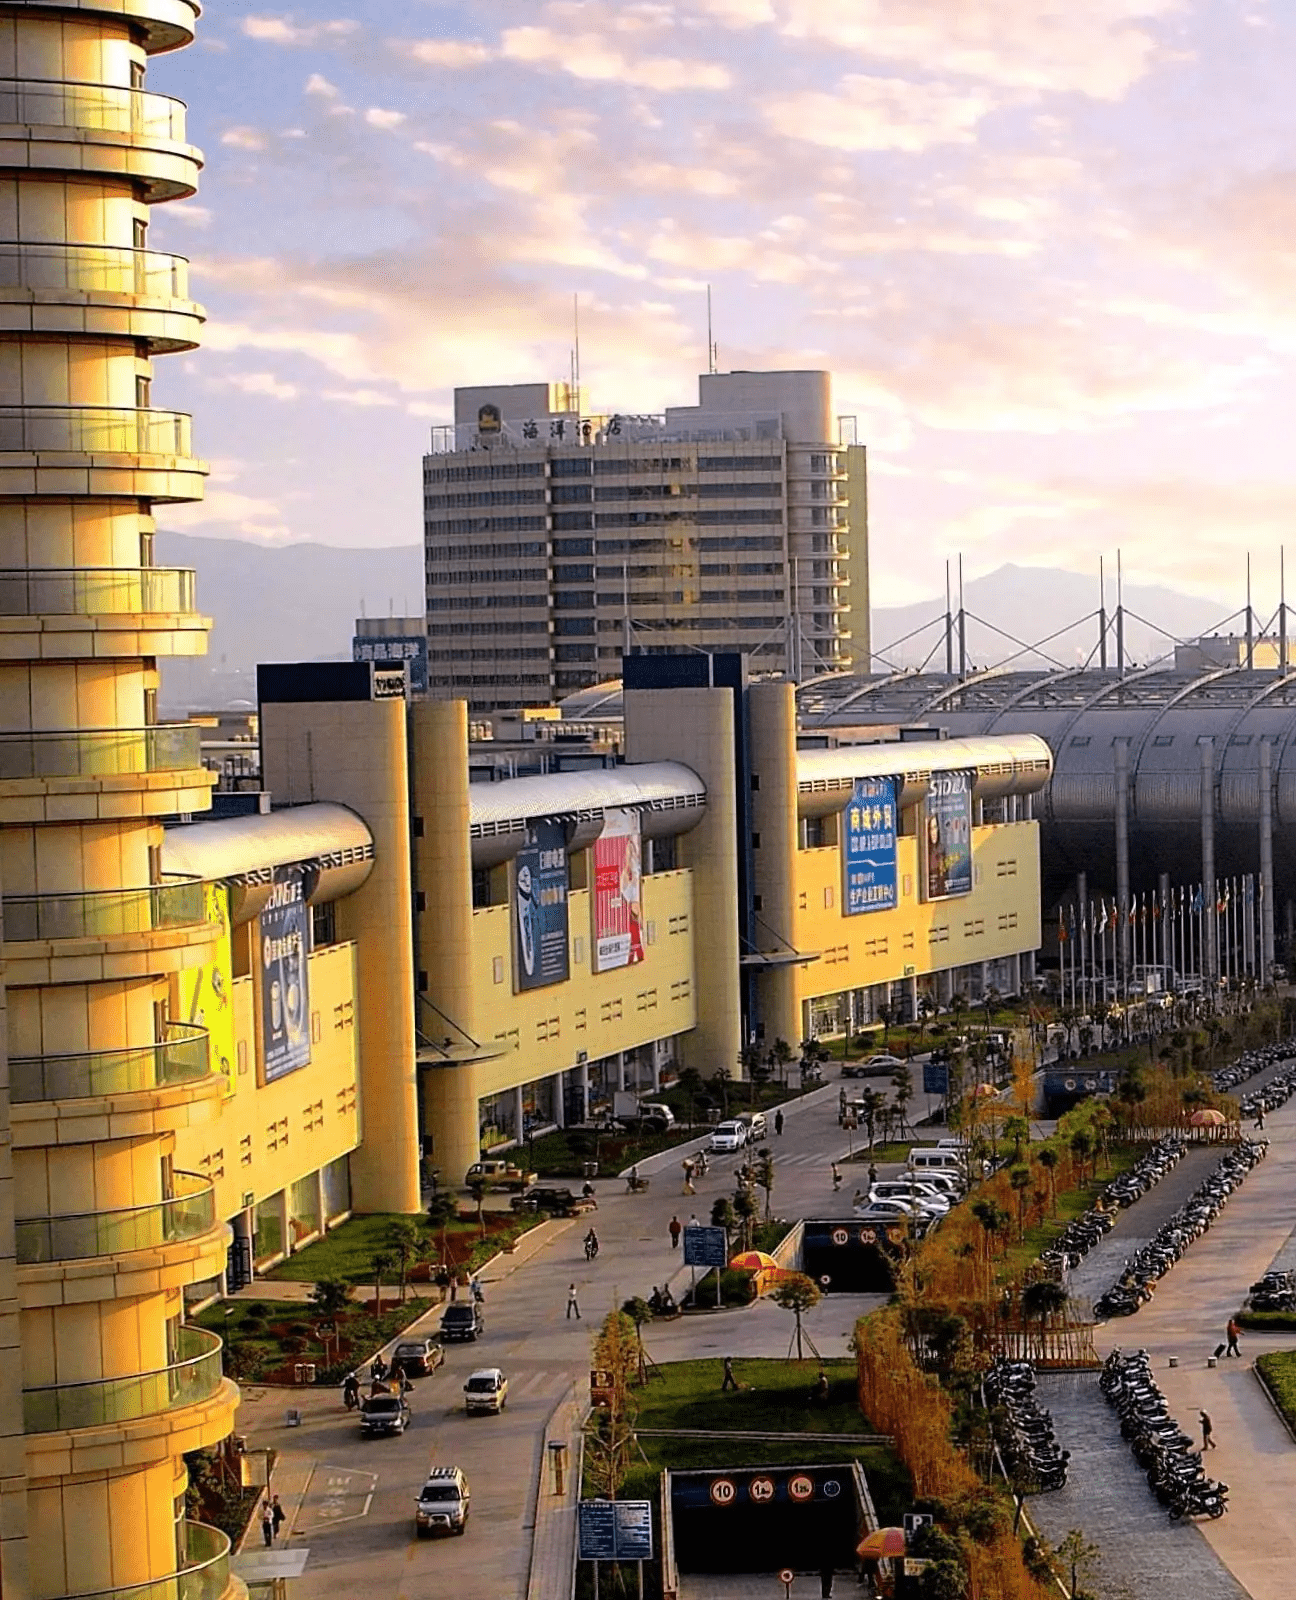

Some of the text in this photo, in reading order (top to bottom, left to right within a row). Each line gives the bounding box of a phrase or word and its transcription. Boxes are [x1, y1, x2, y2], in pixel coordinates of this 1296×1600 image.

[522, 413, 622, 441] 海洋酒店
[717, 1485, 730, 1498] 10
